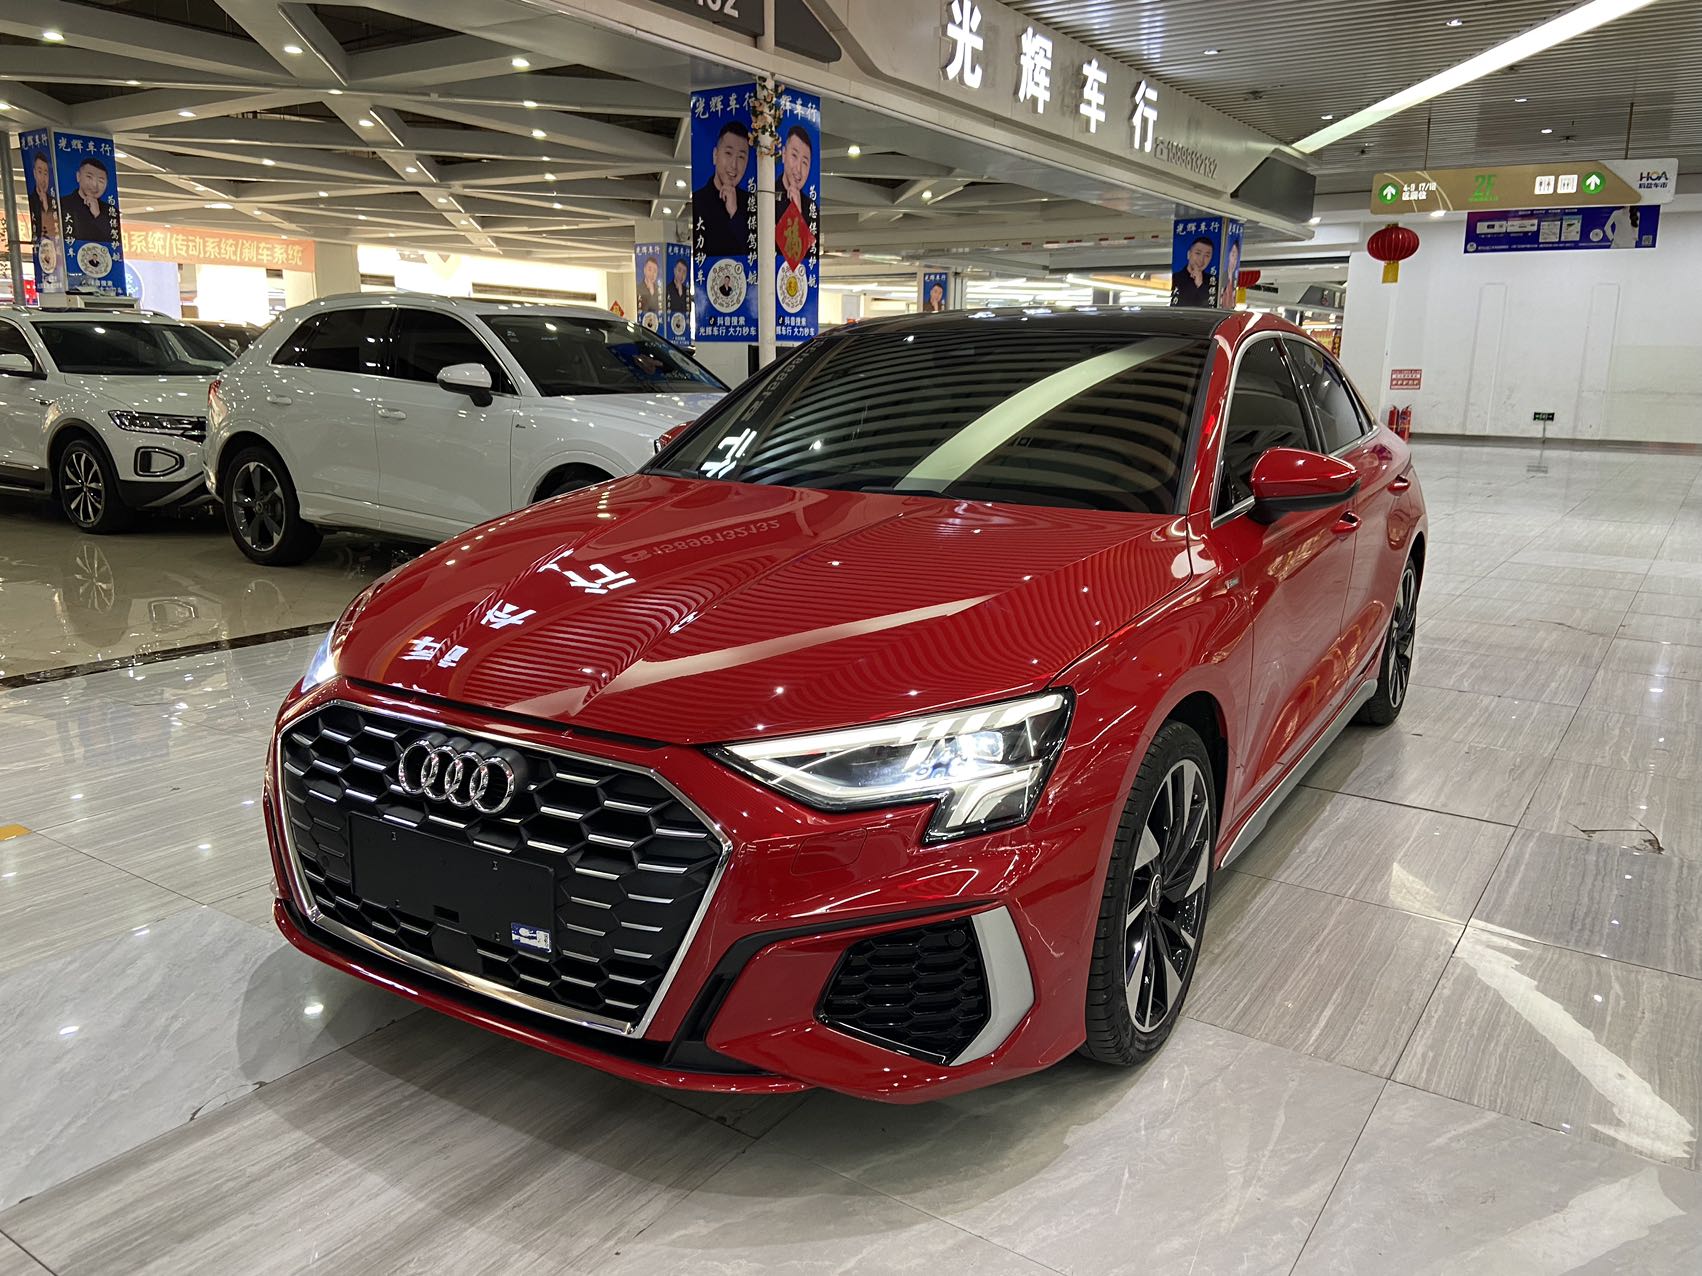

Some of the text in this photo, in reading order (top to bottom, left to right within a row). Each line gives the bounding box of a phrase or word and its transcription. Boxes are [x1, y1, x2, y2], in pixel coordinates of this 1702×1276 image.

[946, 0, 1158, 153] 光辉车行
[58, 137, 112, 156] 光辉车行
